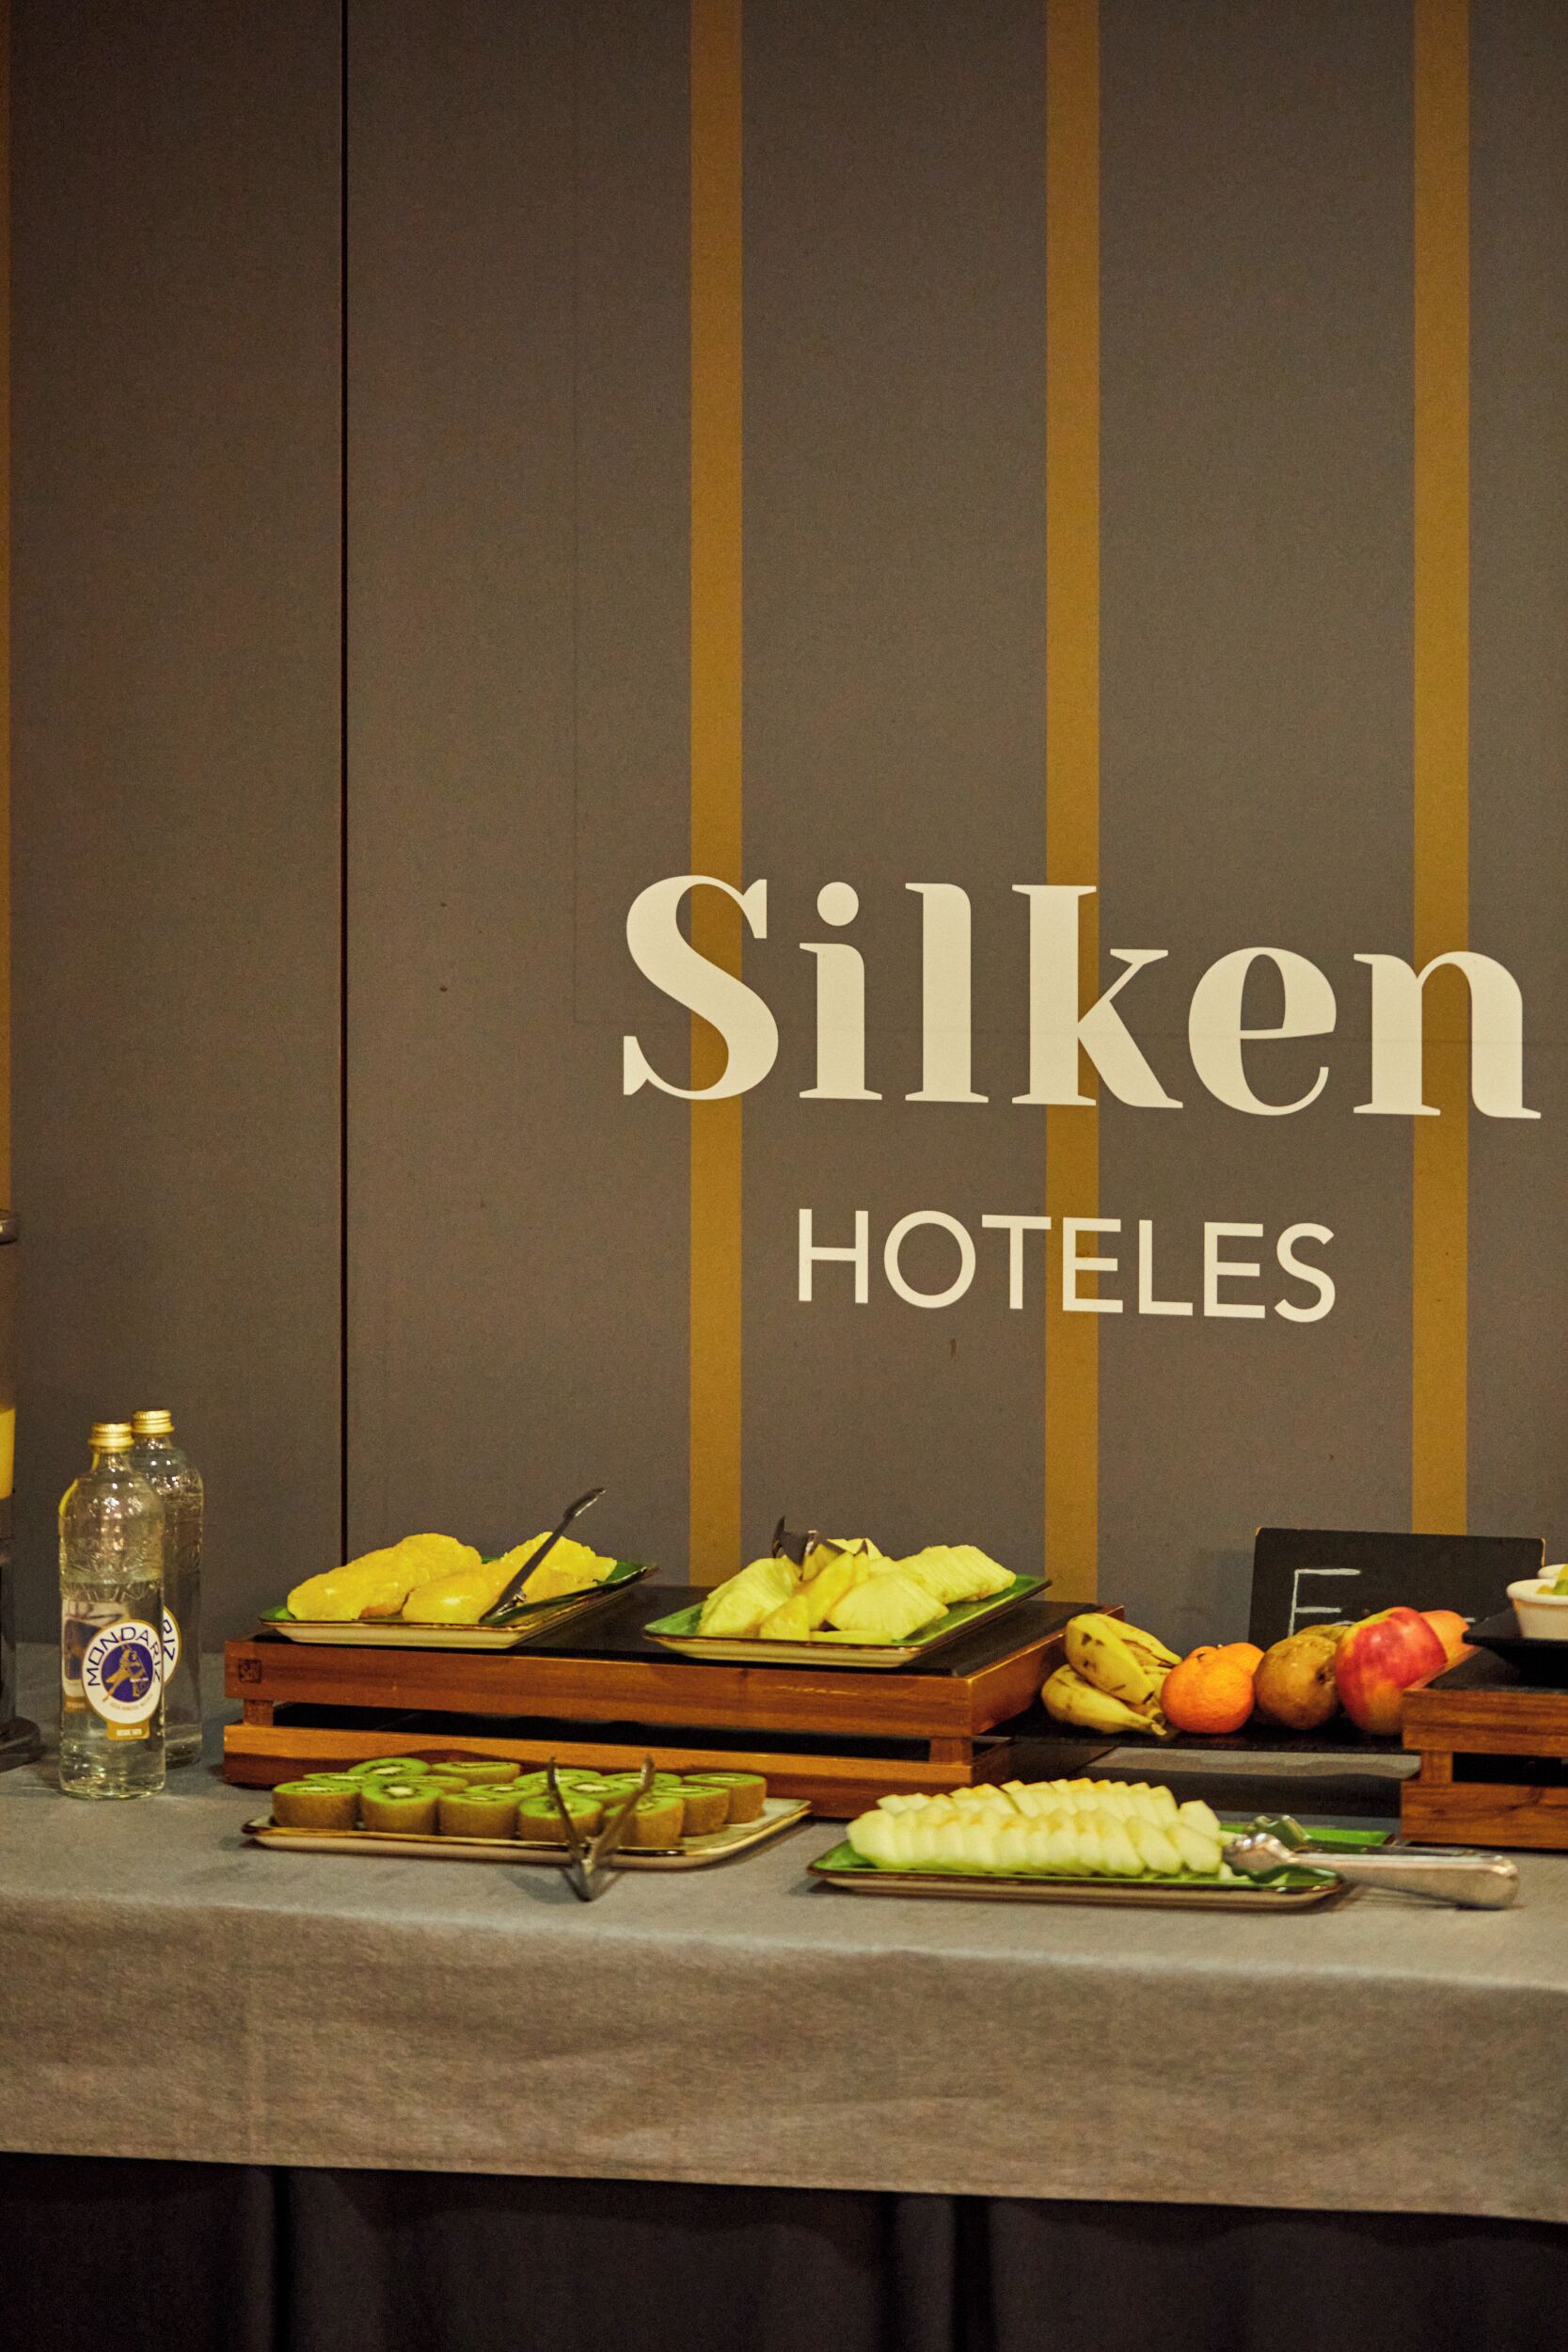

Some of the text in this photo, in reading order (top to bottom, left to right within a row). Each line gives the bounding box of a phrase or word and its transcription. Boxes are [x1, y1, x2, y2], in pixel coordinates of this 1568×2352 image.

[623, 875, 1542, 1120] Silken
[798, 1208, 1336, 1323] HOTELES
[86, 1627, 161, 1687] MONDARIZ
